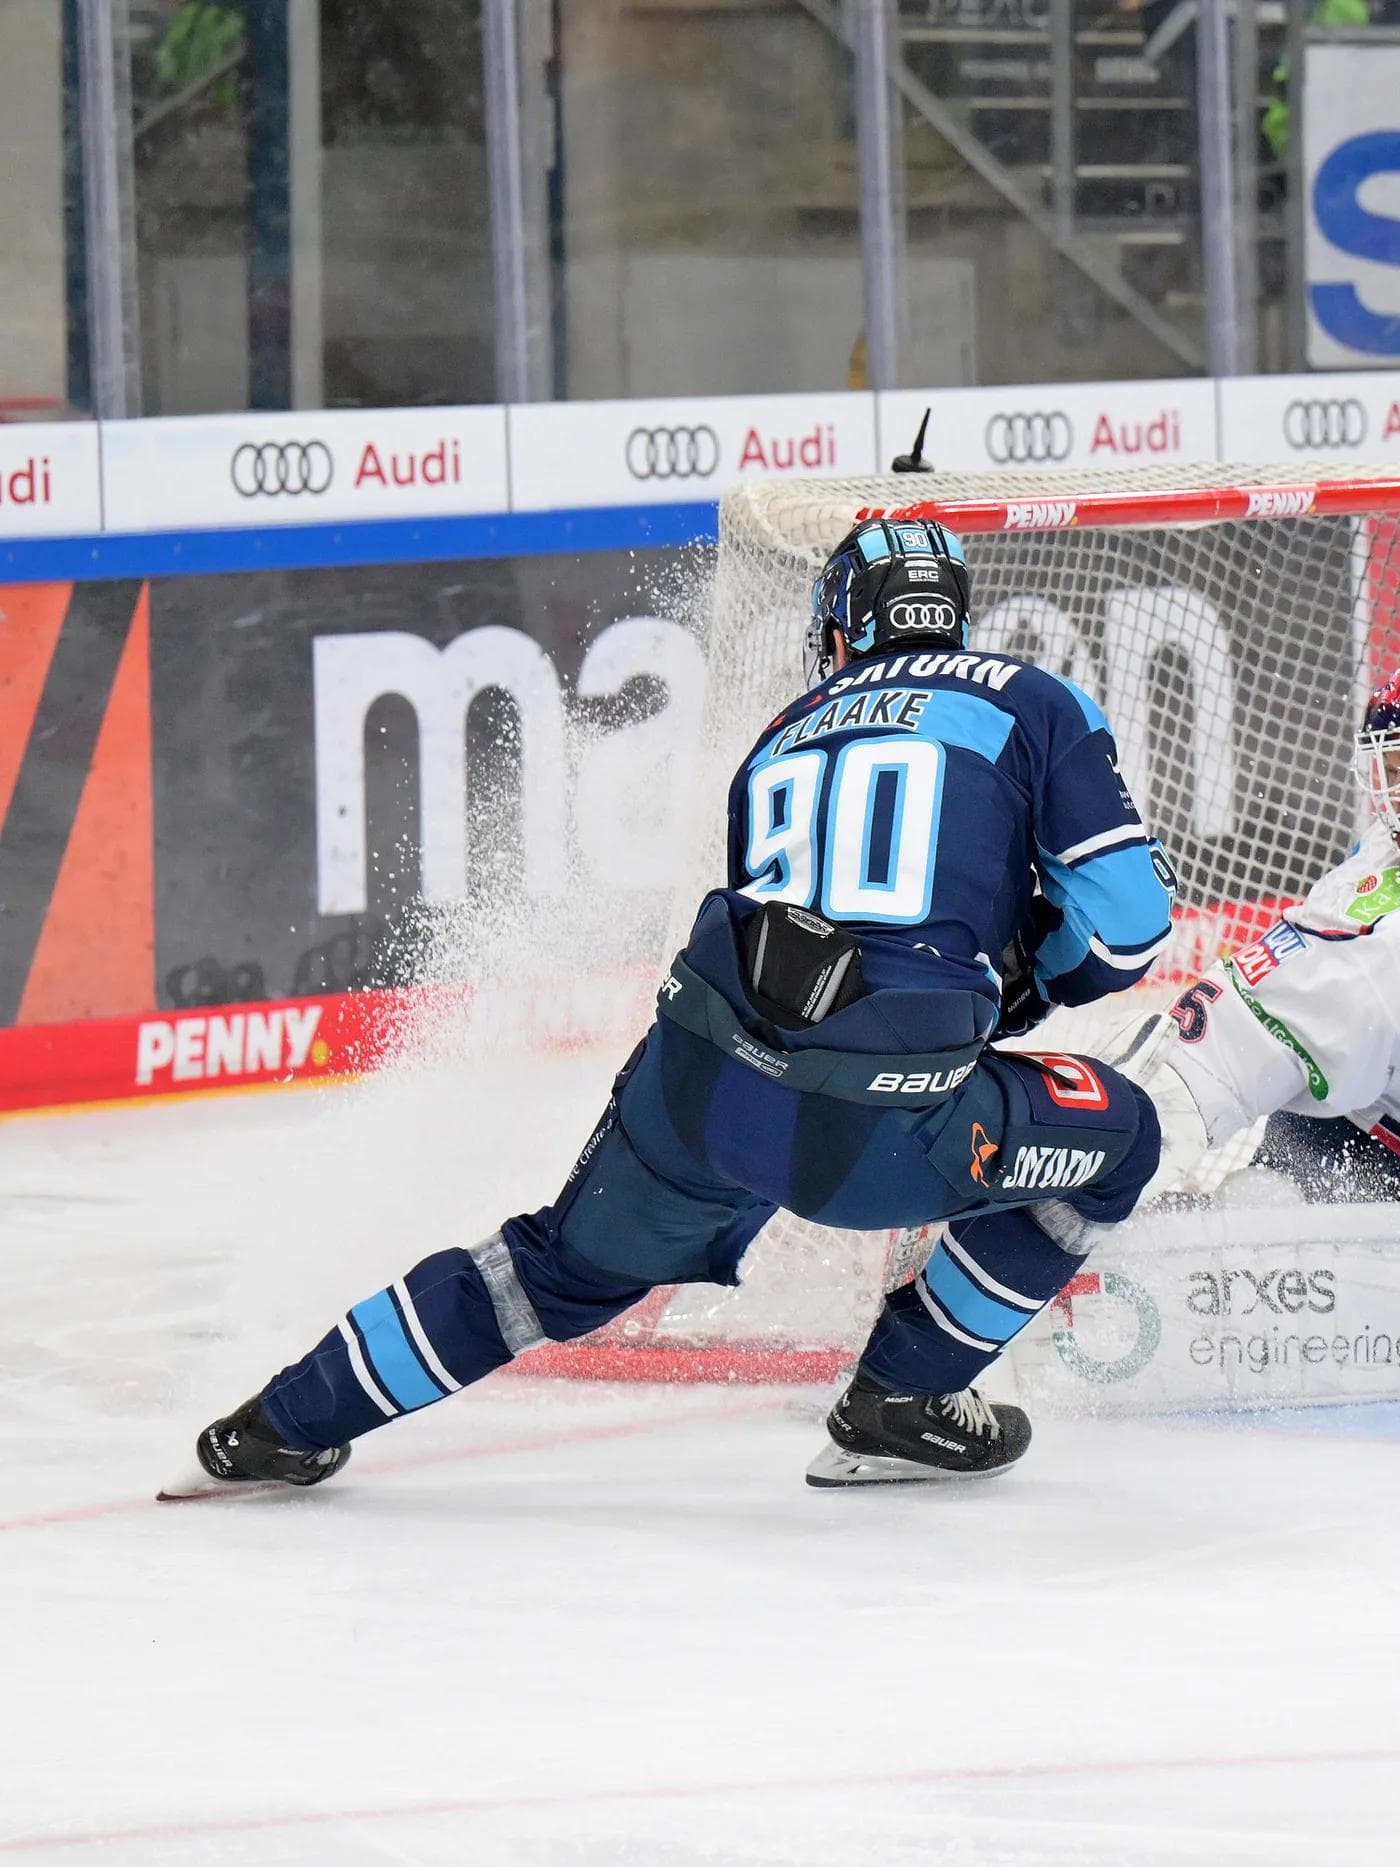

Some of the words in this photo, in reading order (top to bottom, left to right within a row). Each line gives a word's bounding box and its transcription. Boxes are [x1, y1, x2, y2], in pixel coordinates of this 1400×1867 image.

[739, 425, 837, 471] Audi
[1090, 410, 1181, 457] Audi
[0, 457, 51, 504] di
[354, 440, 461, 488] Audi
[902, 532, 929, 549] 90
[908, 570, 939, 579] ERC
[769, 689, 934, 759] FLAAKE
[737, 734, 947, 925] 90
[1186, 1268, 1336, 1315] arxes
